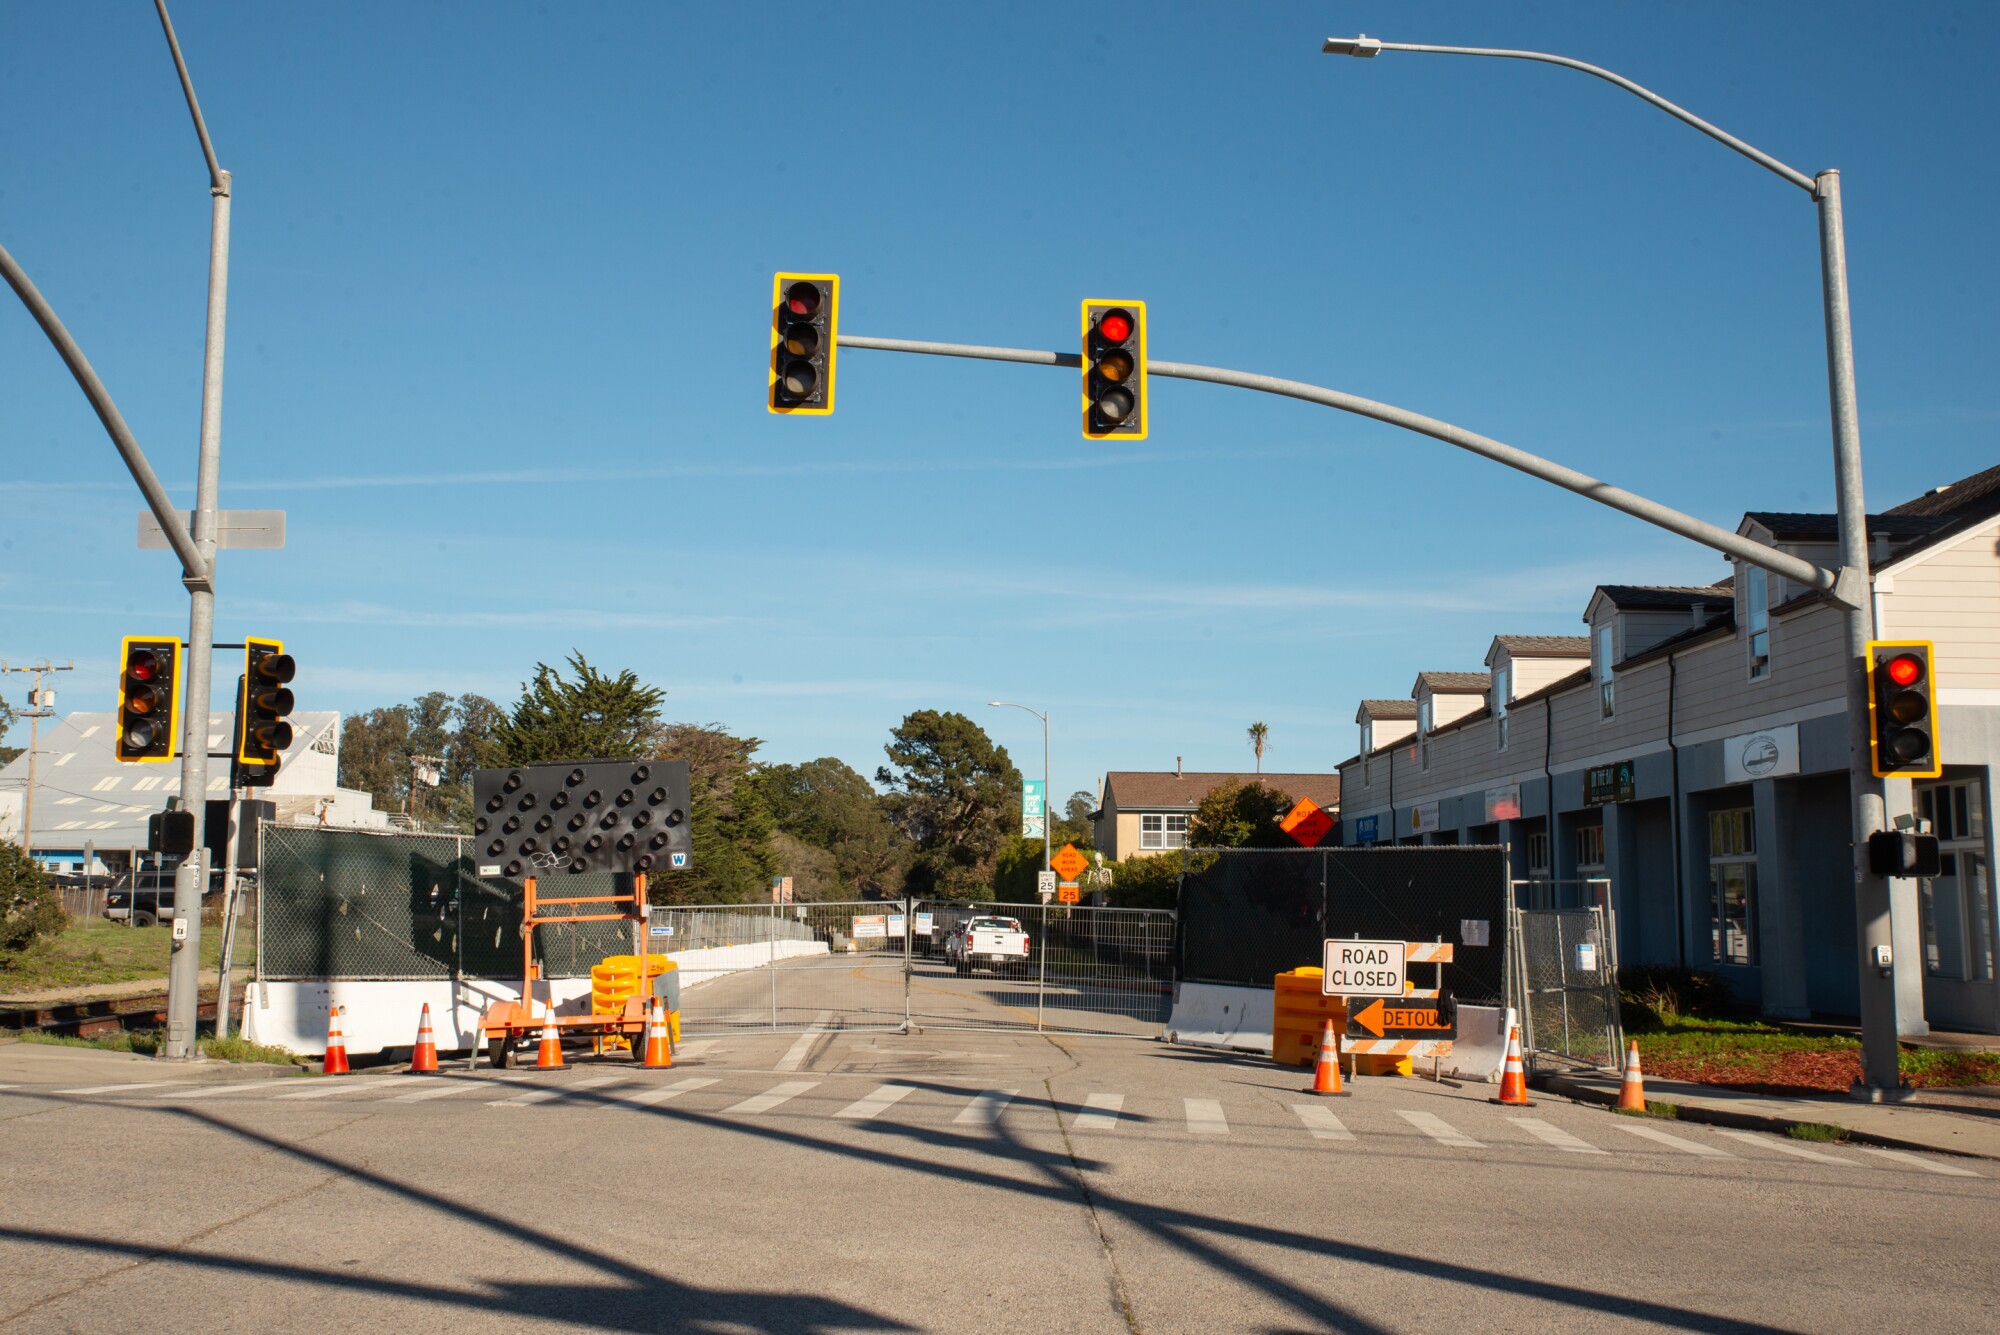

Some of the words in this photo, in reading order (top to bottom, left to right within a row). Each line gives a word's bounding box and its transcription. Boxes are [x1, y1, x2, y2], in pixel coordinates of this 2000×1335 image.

[1296, 810, 1318, 819] ROAD
[1297, 820, 1318, 828] WORK
[1297, 830, 1322, 838] AHEAD
[673, 854, 685, 865] W
[1040, 882, 1054, 890] 25
[1062, 892, 1076, 900] 25
[1342, 949, 1389, 964] ROAD
[1332, 970, 1397, 986] CLOSED
[1383, 1010, 1440, 1027] DETOU
